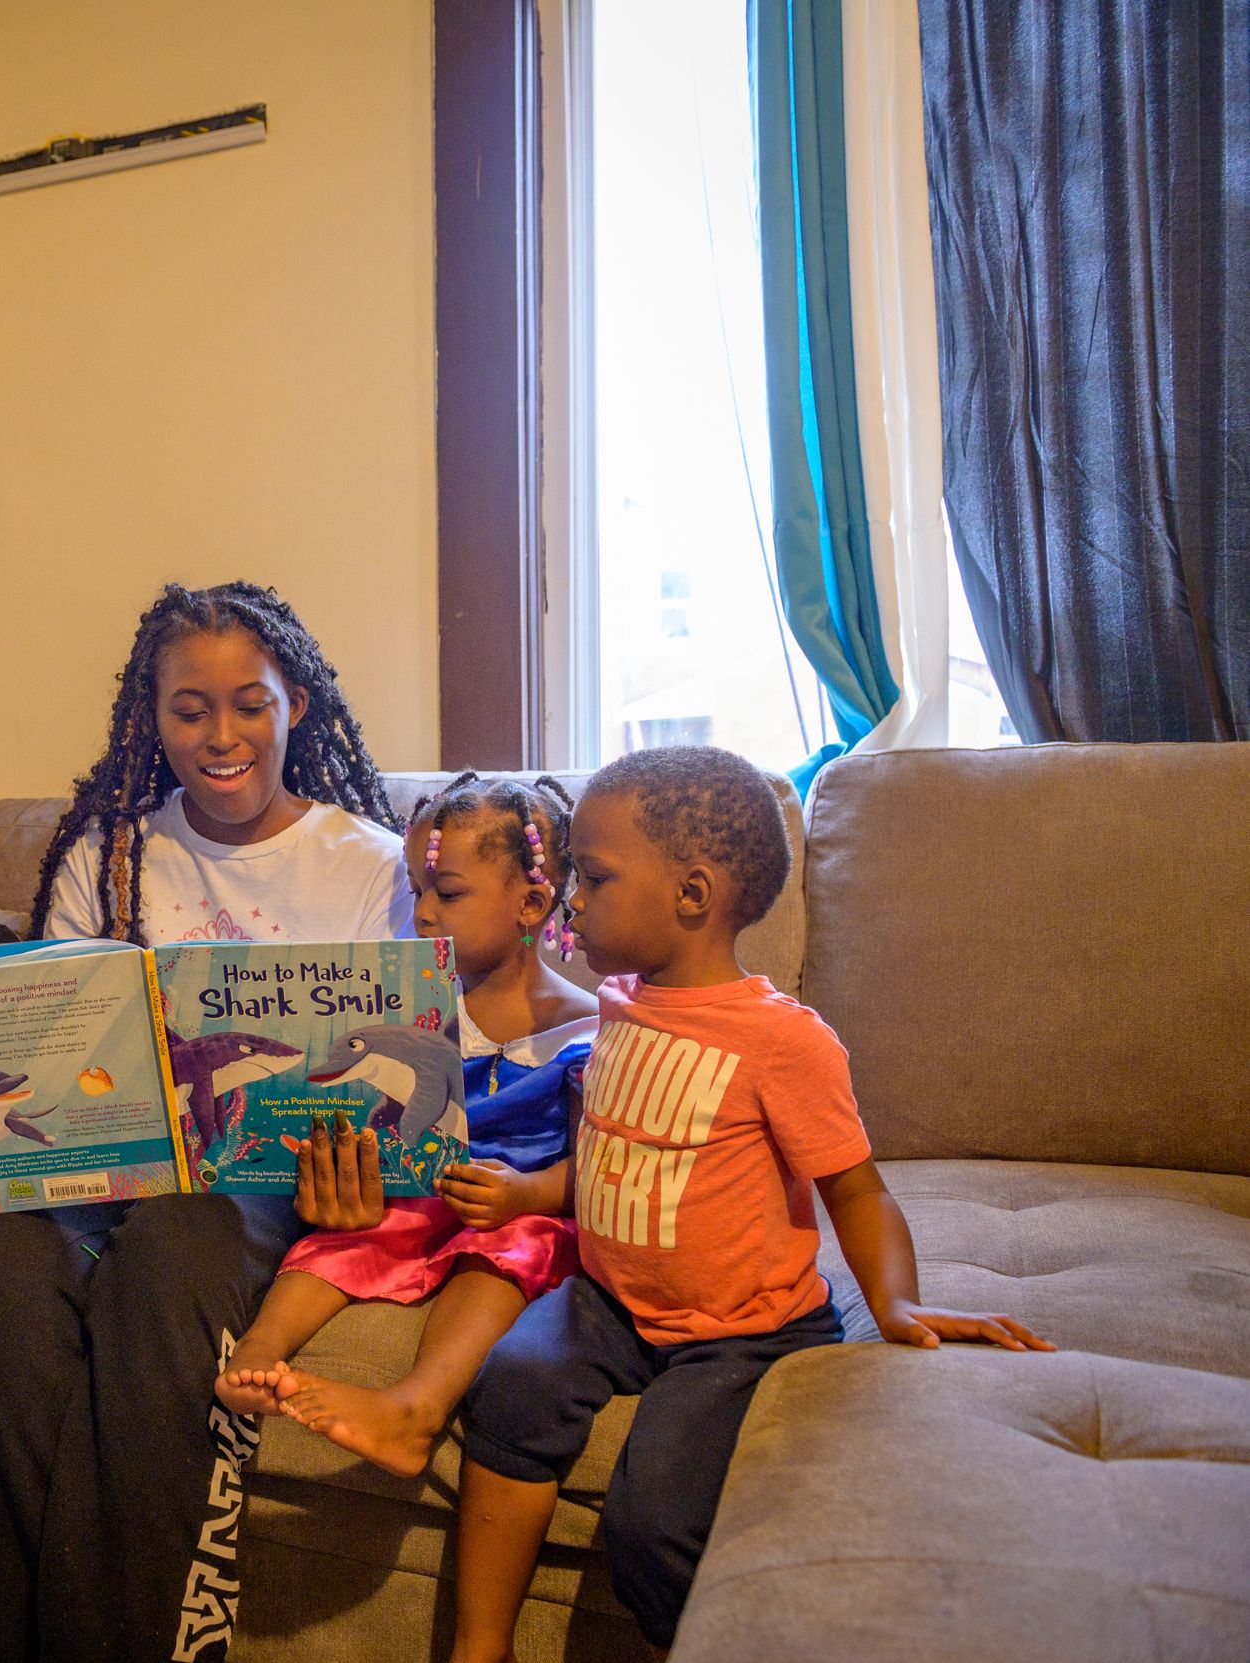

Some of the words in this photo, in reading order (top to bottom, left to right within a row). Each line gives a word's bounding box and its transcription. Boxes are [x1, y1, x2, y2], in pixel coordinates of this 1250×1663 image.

[147, 970, 156, 985] How
[223, 964, 268, 985] How
[275, 963, 294, 983] to
[300, 962, 354, 983] Make
[359, 967, 371, 982] a
[24, 980, 62, 992] happiness
[63, 978, 78, 987] and
[0, 995, 9, 1003] of
[16, 990, 46, 1003] positive
[46, 987, 78, 997] mindset
[199, 988, 298, 1019] Shark
[310, 984, 403, 1017] Smile
[151, 994, 160, 1013] Make
[155, 1019, 164, 1037] Shark
[260, 1098, 281, 1106] How
[291, 1097, 325, 1106] Positive
[327, 1097, 365, 1106] Mindset
[271, 1107, 308, 1117] Spreads
